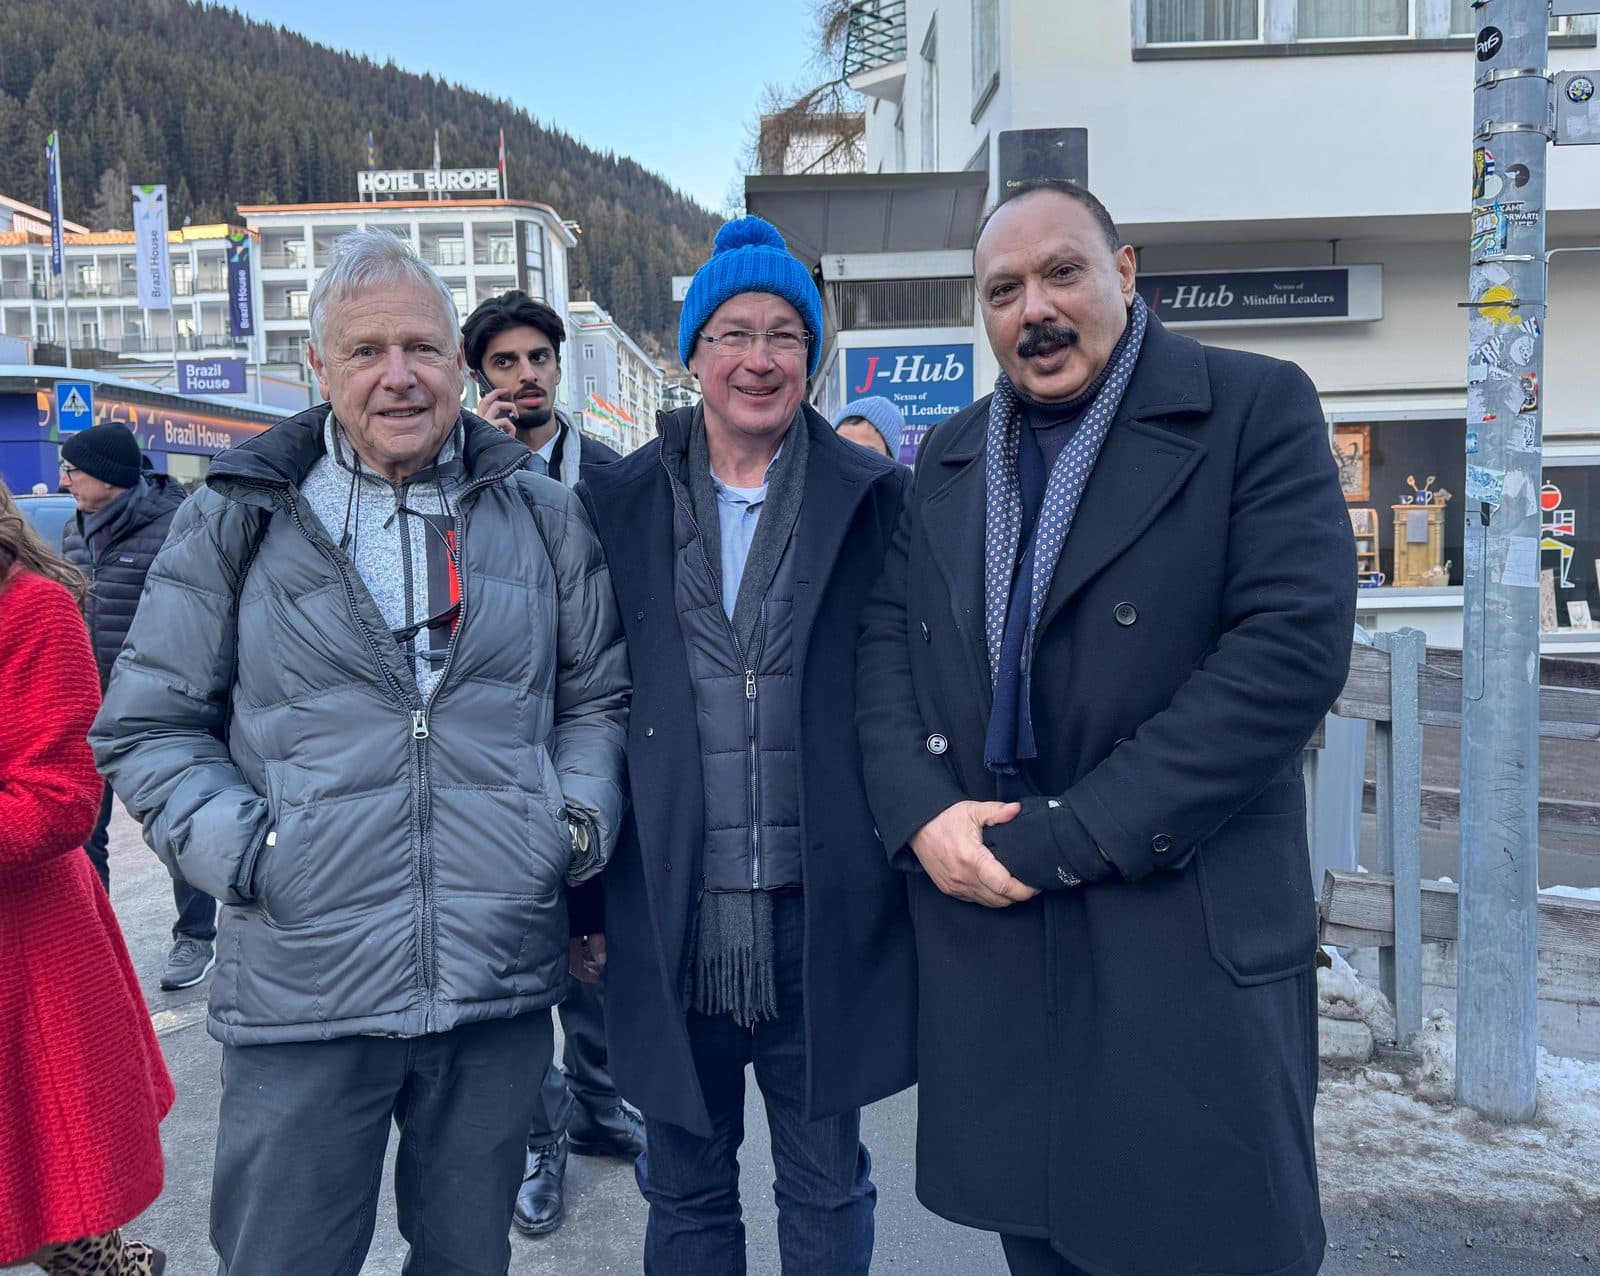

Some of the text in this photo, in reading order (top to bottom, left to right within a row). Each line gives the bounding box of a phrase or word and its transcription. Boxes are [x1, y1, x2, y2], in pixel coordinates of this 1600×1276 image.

[358, 170, 498, 191] HOTEL EUROPE
[152, 268, 160, 298] Brazil
[238, 270, 250, 329] Brazil House
[1242, 293, 1335, 306] Mindful Leaders
[186, 364, 221, 377] Brazil
[855, 353, 964, 393] J-Hub
[187, 377, 230, 389] House
[894, 392, 928, 401] Nexus of
[912, 404, 960, 416] Leaders
[165, 420, 231, 449] Brazil House
